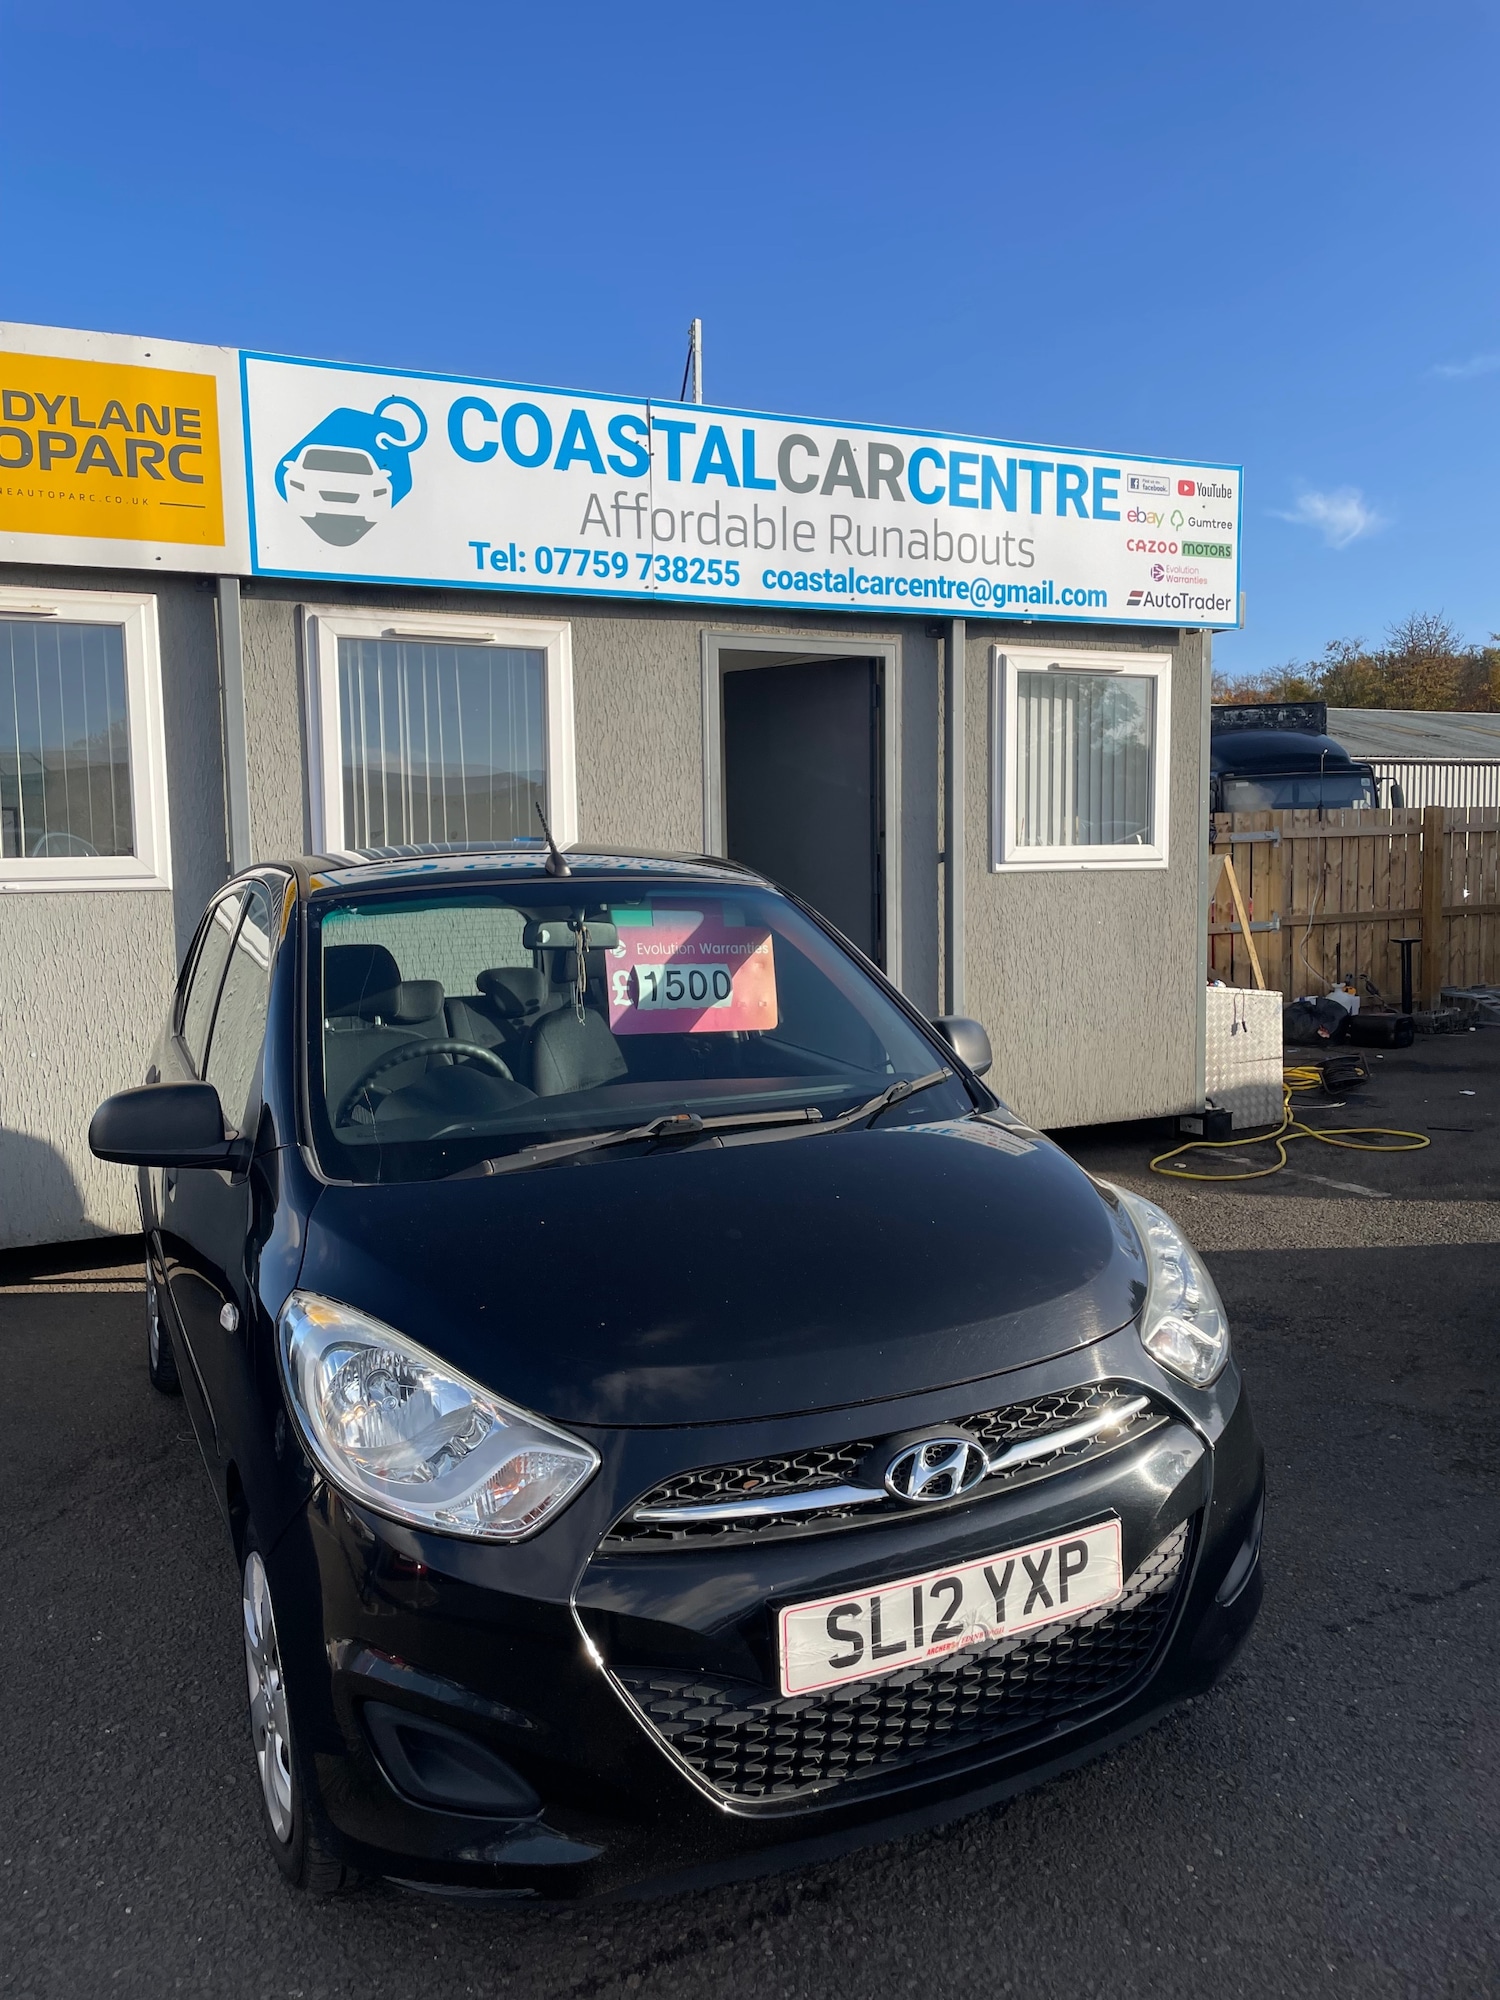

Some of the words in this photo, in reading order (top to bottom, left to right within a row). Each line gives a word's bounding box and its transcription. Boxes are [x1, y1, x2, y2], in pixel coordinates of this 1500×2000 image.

[2, 389, 201, 439] DYLANE
[1197, 482, 1232, 499] YouTube
[1127, 506, 1164, 528] ebay
[1188, 517, 1232, 530] Gumtree
[580, 491, 815, 552] Affordable
[829, 514, 1035, 568] Runabouts
[1126, 539, 1178, 554] CAZOO
[468, 541, 526, 572] Tel:
[534, 546, 629, 579] 07759
[636, 553, 740, 587] 738255
[1166, 565, 1199, 575] Evolution
[762, 567, 1107, 607] coastalcarcentre@gmail.com
[1166, 573, 1208, 585] Warranties
[1143, 591, 1231, 611] AutoTrader
[637, 942, 696, 956] Evolution
[699, 942, 769, 955] Warranties
[826, 1577, 964, 1669] SL12
[984, 1540, 1089, 1624] YXP
